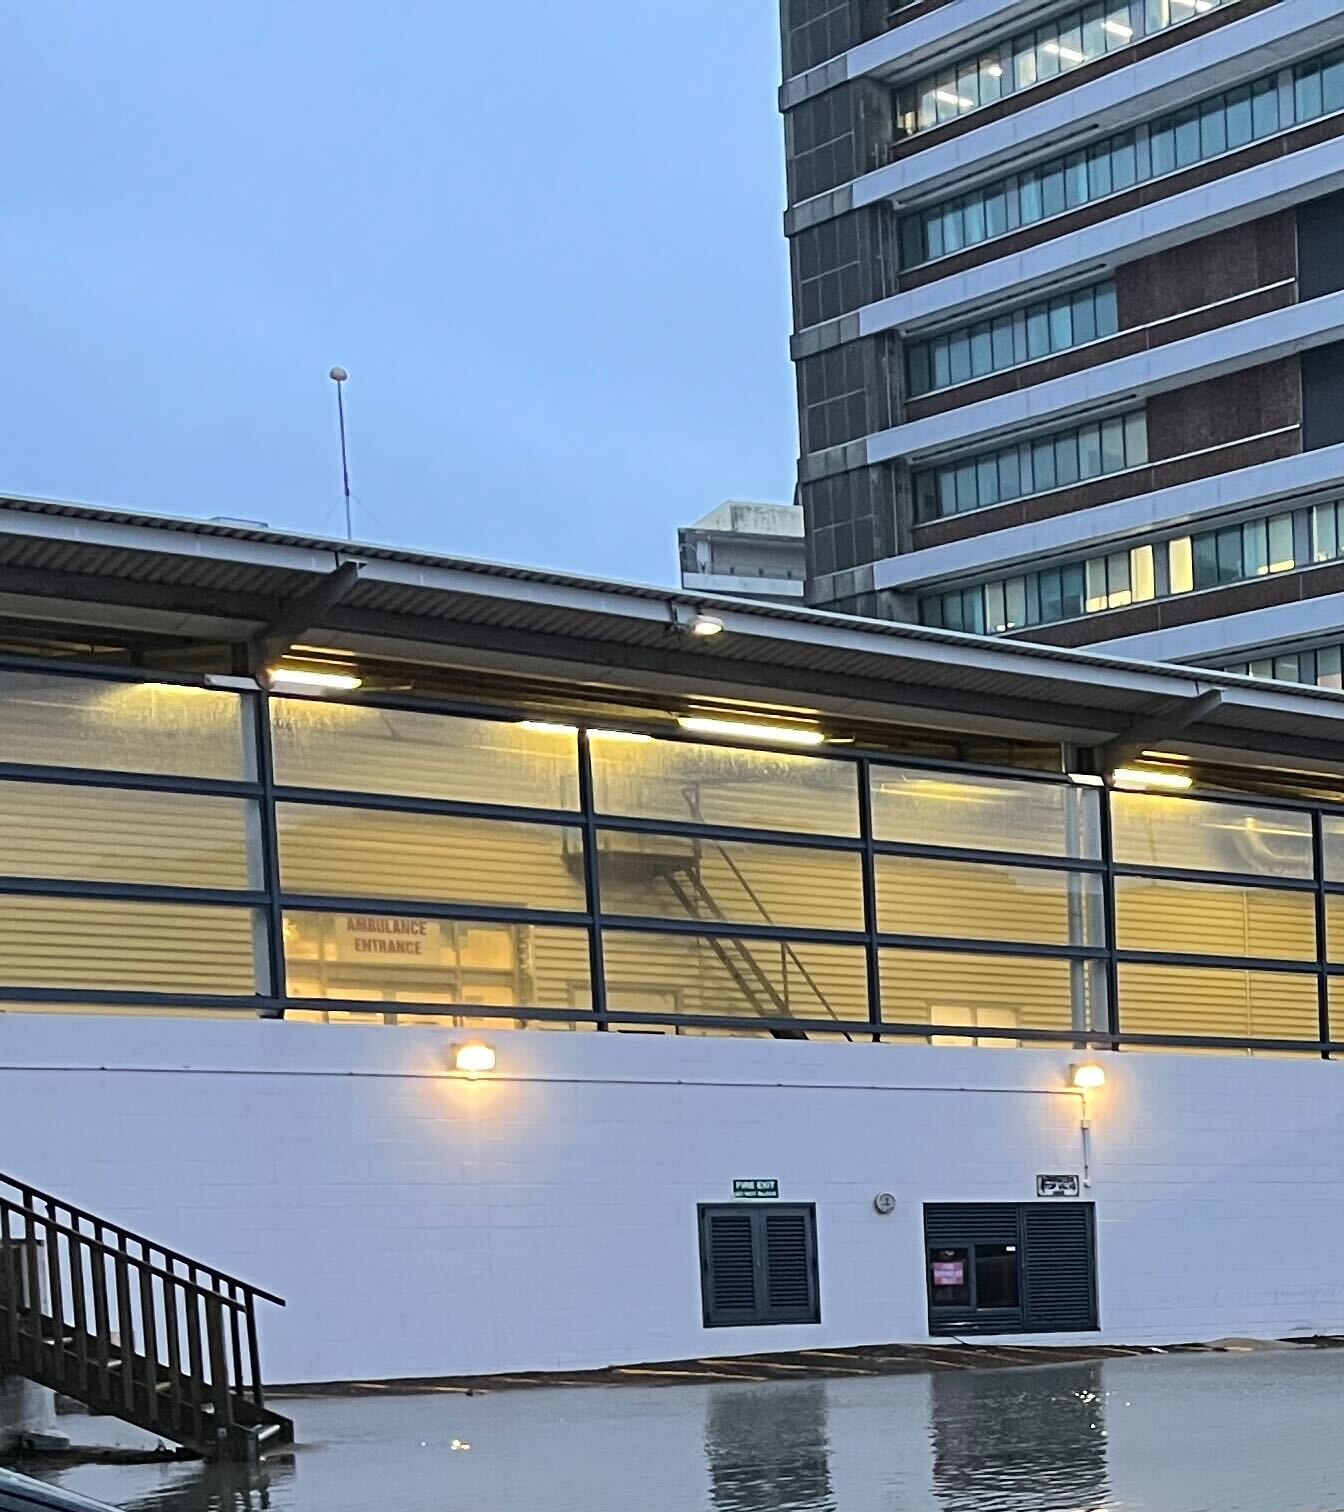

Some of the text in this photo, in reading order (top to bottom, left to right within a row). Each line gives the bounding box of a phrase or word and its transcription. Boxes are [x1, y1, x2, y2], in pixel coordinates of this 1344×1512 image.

[347, 917, 427, 935] AMBULANCE
[354, 937, 422, 955] ENTRANCE
[756, 1181, 775, 1190] EXIT
